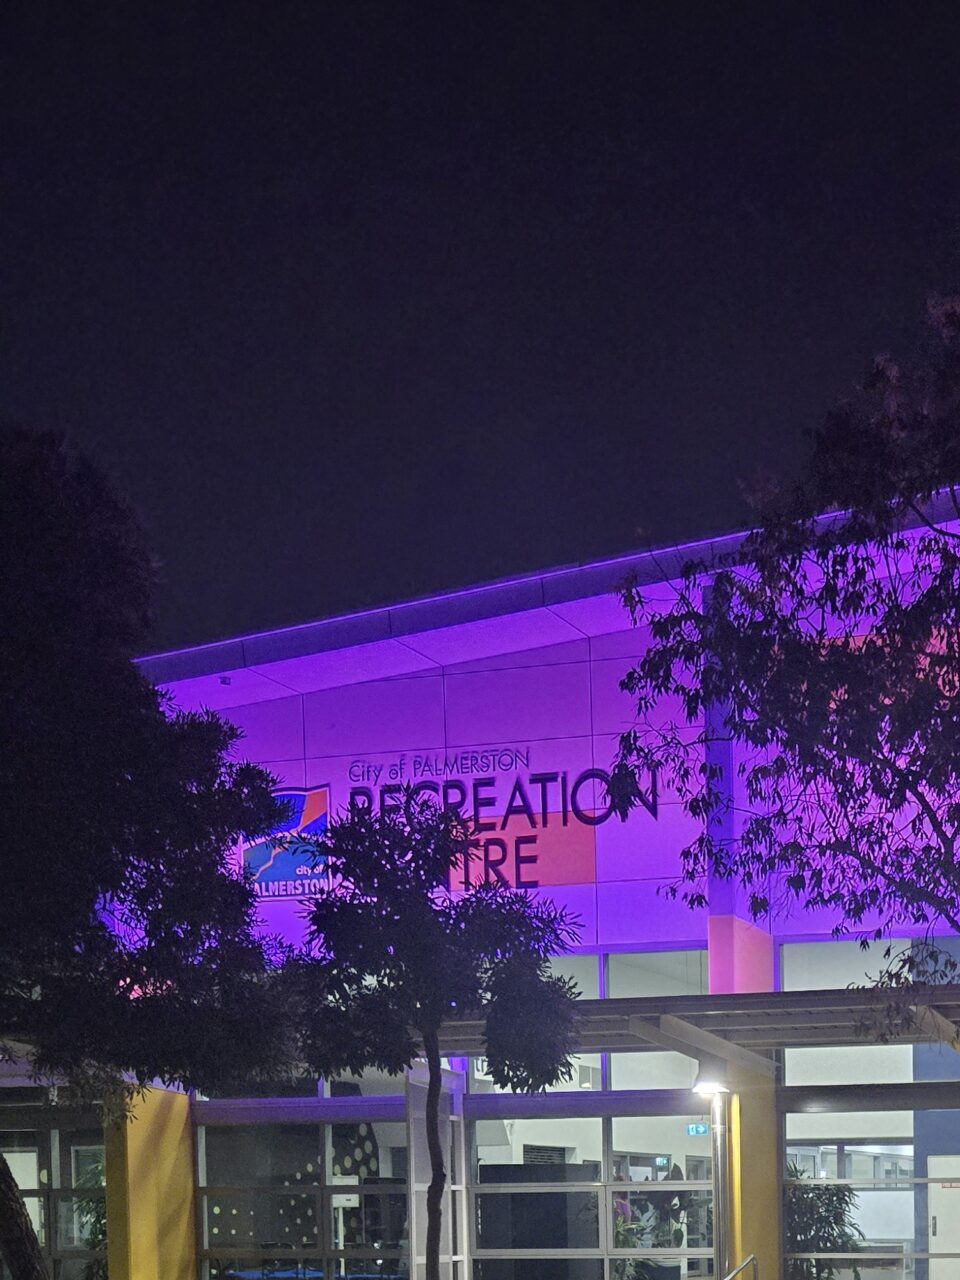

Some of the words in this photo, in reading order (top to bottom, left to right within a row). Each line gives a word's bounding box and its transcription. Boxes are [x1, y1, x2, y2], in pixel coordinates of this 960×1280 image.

[349, 761, 382, 786] City
[388, 757, 405, 780] of
[413, 751, 530, 778] PALMERSTON
[250, 878, 328, 897] ALMERSTON
